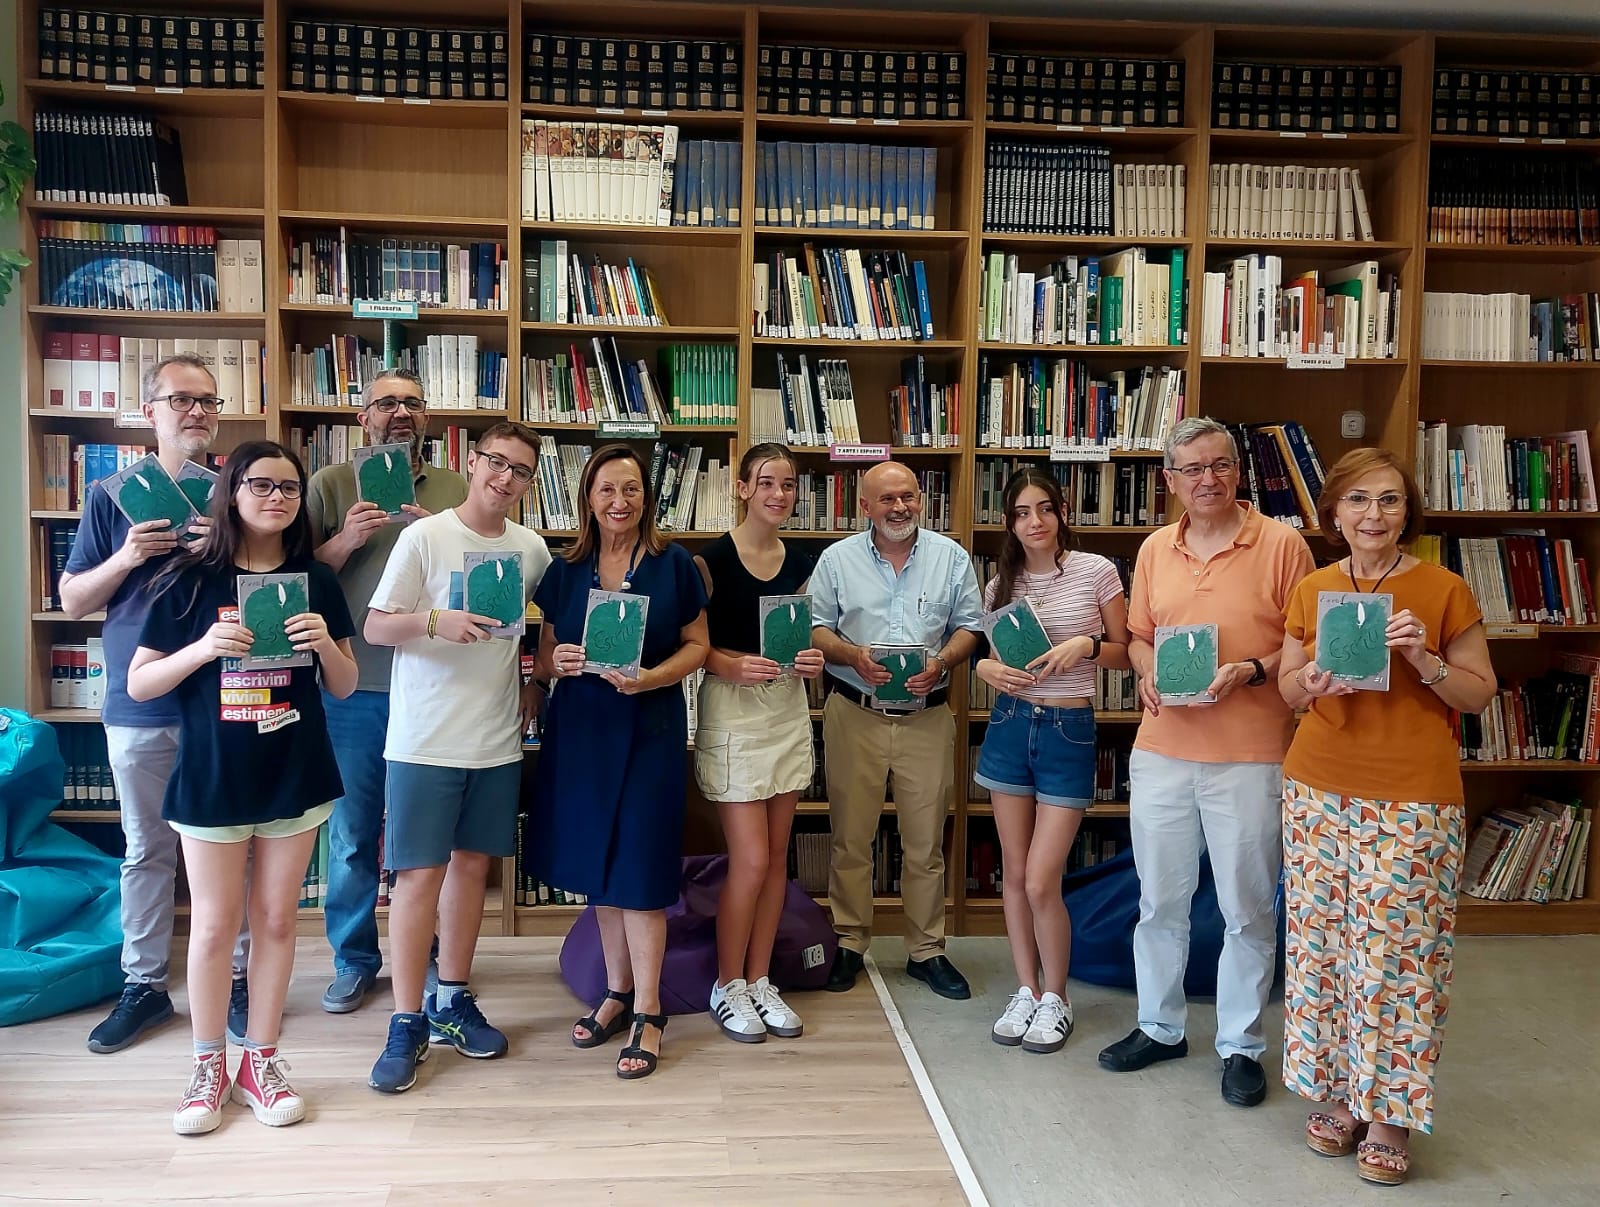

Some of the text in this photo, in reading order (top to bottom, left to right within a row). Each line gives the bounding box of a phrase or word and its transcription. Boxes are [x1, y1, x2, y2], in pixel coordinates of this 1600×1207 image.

[222, 674, 287, 687] escrivim
[223, 692, 264, 703] vivim
[222, 706, 286, 720] estimem
